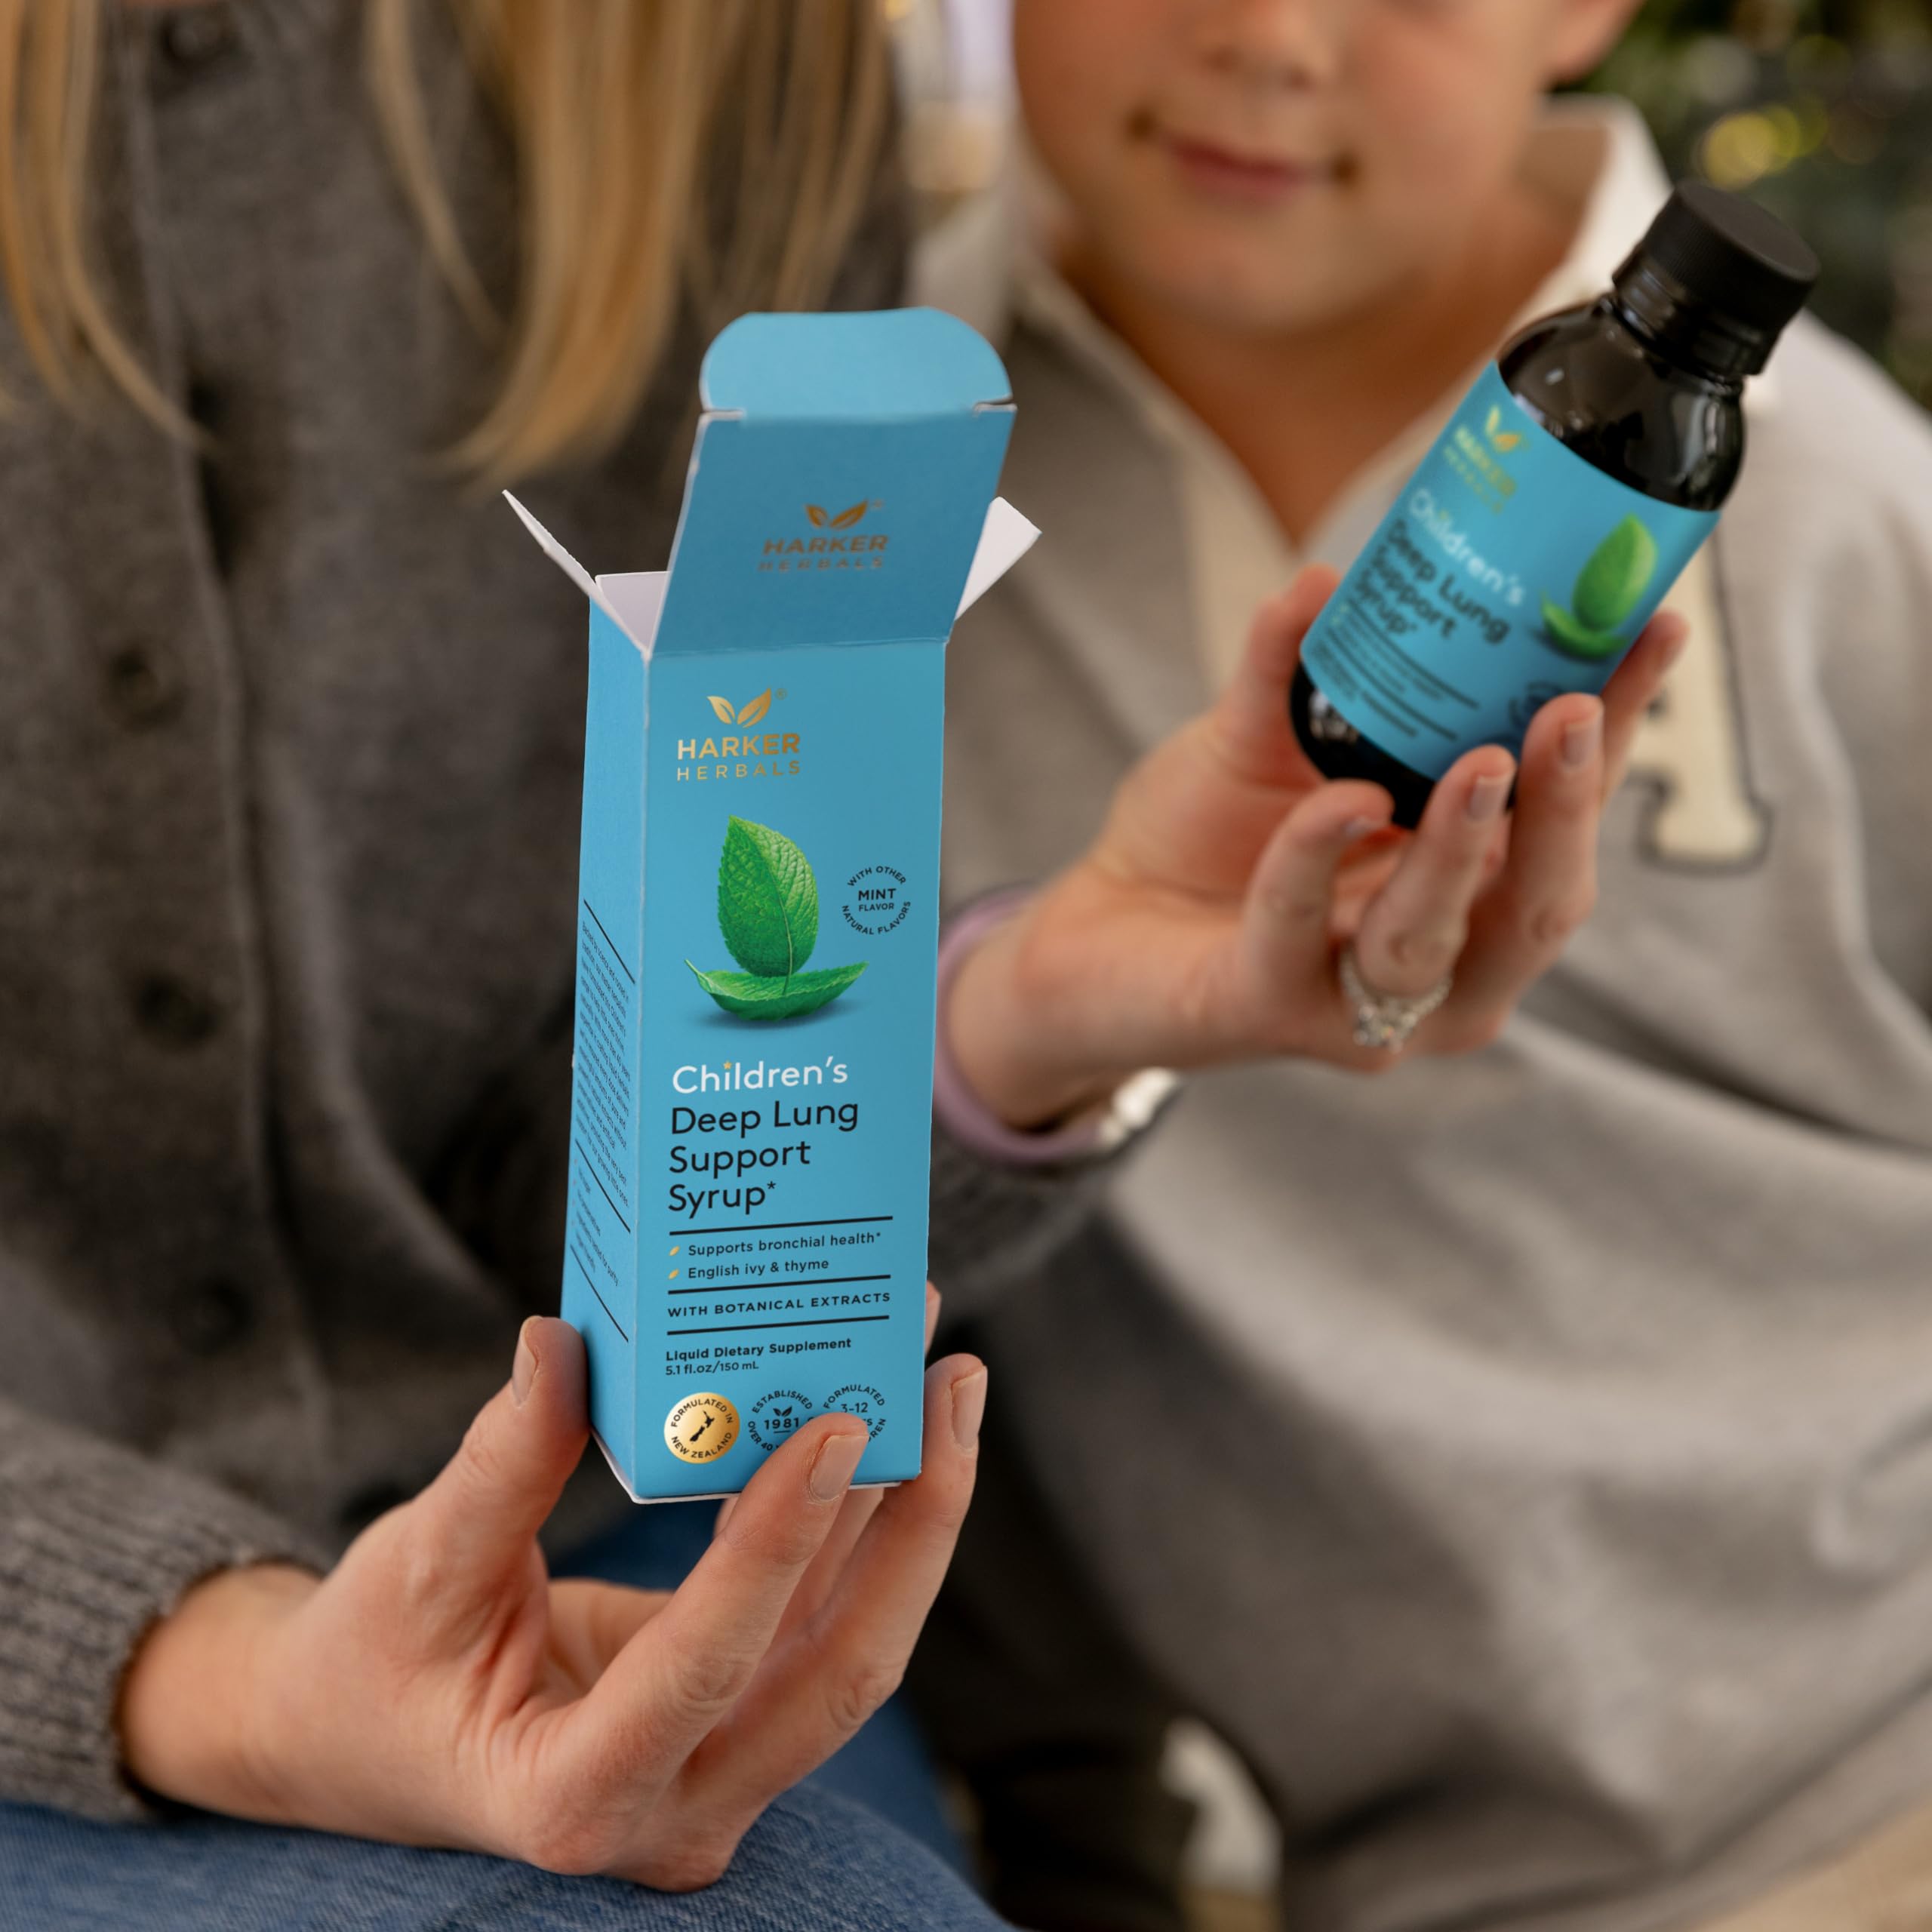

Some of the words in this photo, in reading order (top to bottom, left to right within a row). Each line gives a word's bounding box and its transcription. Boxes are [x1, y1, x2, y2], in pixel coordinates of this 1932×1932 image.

[762, 535, 889, 555] HARKER
[1438, 574, 1510, 645] Lung
[677, 733, 801, 760] HARKER
[677, 760, 801, 781] HERBALS
[847, 867, 872, 887] WITH
[875, 866, 906, 884] OTHER
[858, 888, 897, 901] MINT
[841, 905, 875, 935] NATURAL
[878, 901, 911, 934] FLAVORS
[858, 903, 894, 912] FLAVOR
[672, 1056, 848, 1093] Children's
[672, 1107, 761, 1138] Deep
[774, 1100, 858, 1132] Lung
[669, 1141, 811, 1179] Support
[688, 1241, 753, 1257] Supports
[758, 1236, 825, 1251] bronchial
[688, 1265, 740, 1280] English
[745, 1263, 765, 1275] ivy
[770, 1262, 780, 1272] &
[785, 1260, 829, 1272] thyme
[668, 1306, 708, 1318] WITH
[715, 1299, 804, 1315] BOTANICAL
[811, 1293, 891, 1307] EXTRACTS
[666, 1349, 709, 1361] Liquid
[715, 1344, 764, 1358] Dietary
[769, 1338, 851, 1354] Supplement
[666, 1365, 681, 1375] 5.1
[742, 1361, 759, 1371] mL
[752, 1390, 813, 1414] ESTABLISHED
[823, 1384, 885, 1409] FORMULATED
[671, 1398, 728, 1428] FORMULATED
[725, 1414, 734, 1424] IN
[764, 1417, 799, 1431] 1981
[672, 1436, 690, 1455] NEW
[691, 1432, 732, 1458] ZEALAND
[748, 1421, 762, 1444] OVER
[761, 1442, 773, 1451] 40
